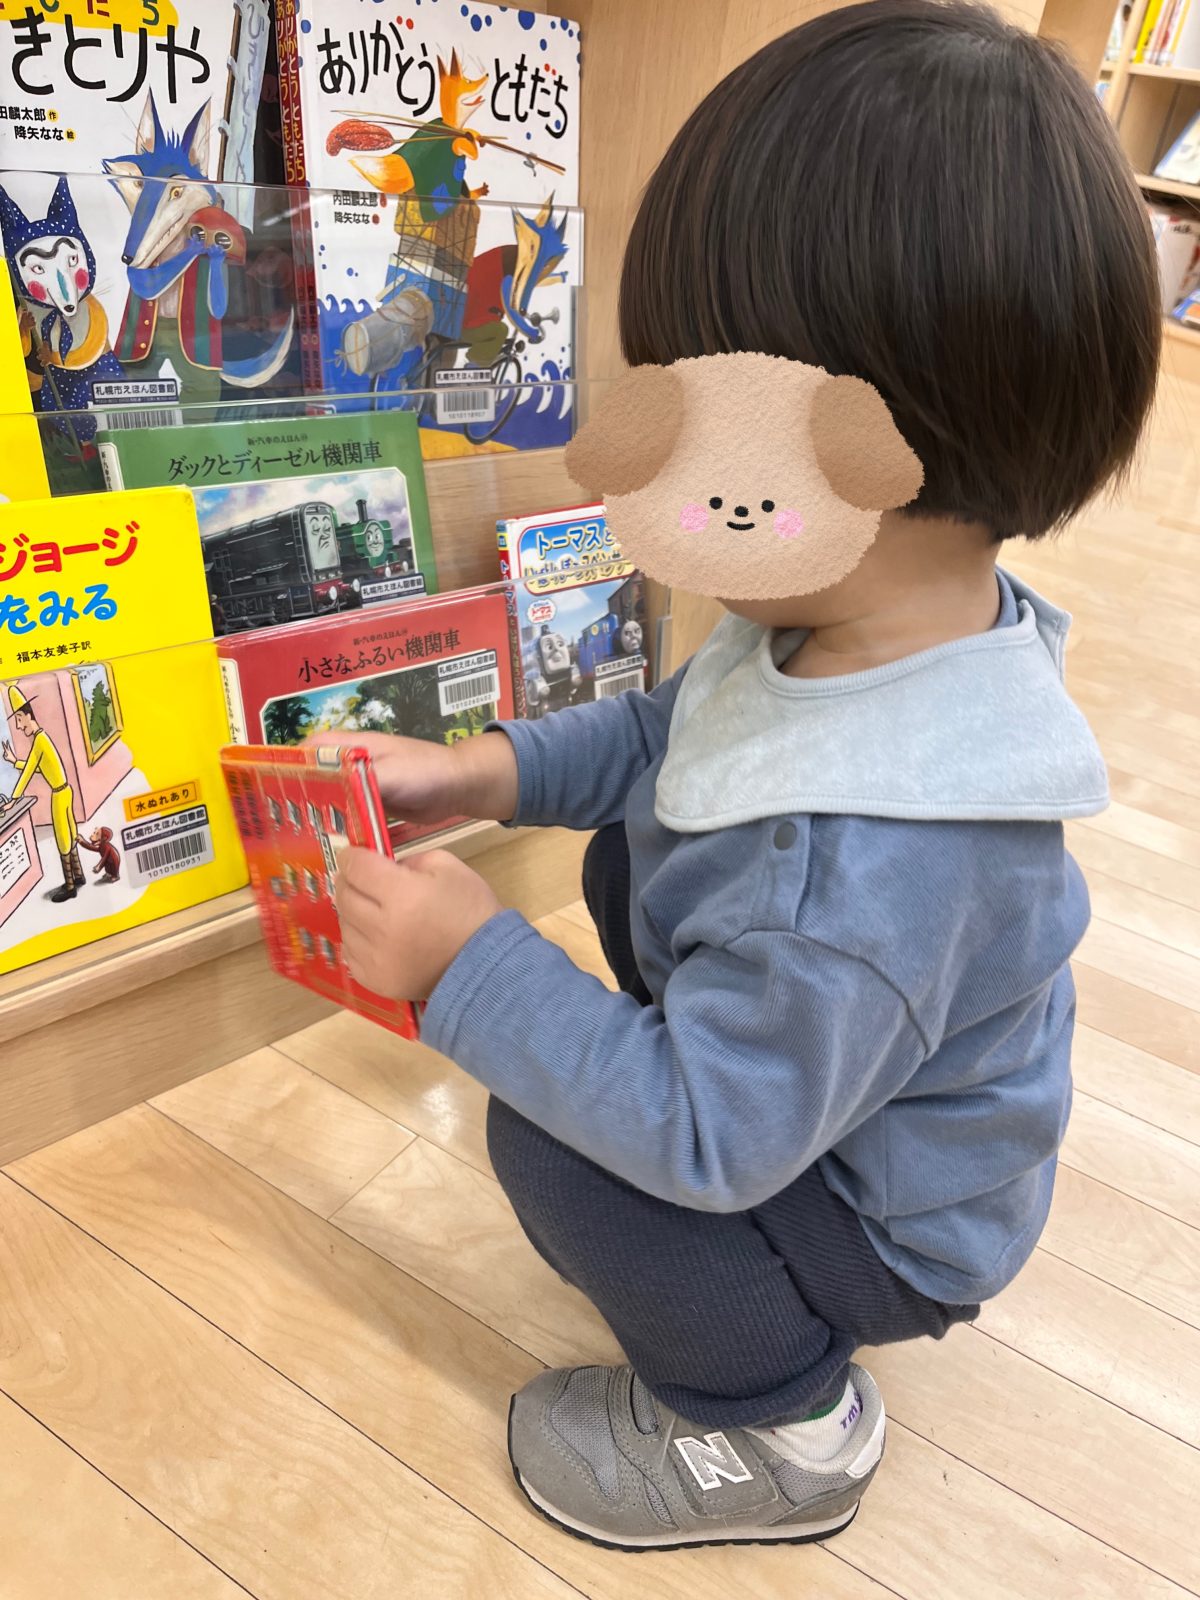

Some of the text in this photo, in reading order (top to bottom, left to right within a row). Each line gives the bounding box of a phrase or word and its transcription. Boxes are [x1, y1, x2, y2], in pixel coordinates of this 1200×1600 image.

[10, 6, 210, 103] きとりや
[317, 15, 569, 139] ありがとう ともだち
[96, 383, 175, 396] 札幌市えほん図書館
[169, 440, 383, 482] ダックとディーゼル機関車
[0, 521, 140, 582] ジョージ
[0, 583, 117, 635] をみる
[16, 641, 92, 663] 福本友美子訳
[298, 629, 461, 683] 小さなふるい機関車
[126, 809, 205, 841] 札幌市えほん図書館
[135, 788, 189, 812] 水ぬれあり
[673, 1431, 753, 1490] N
